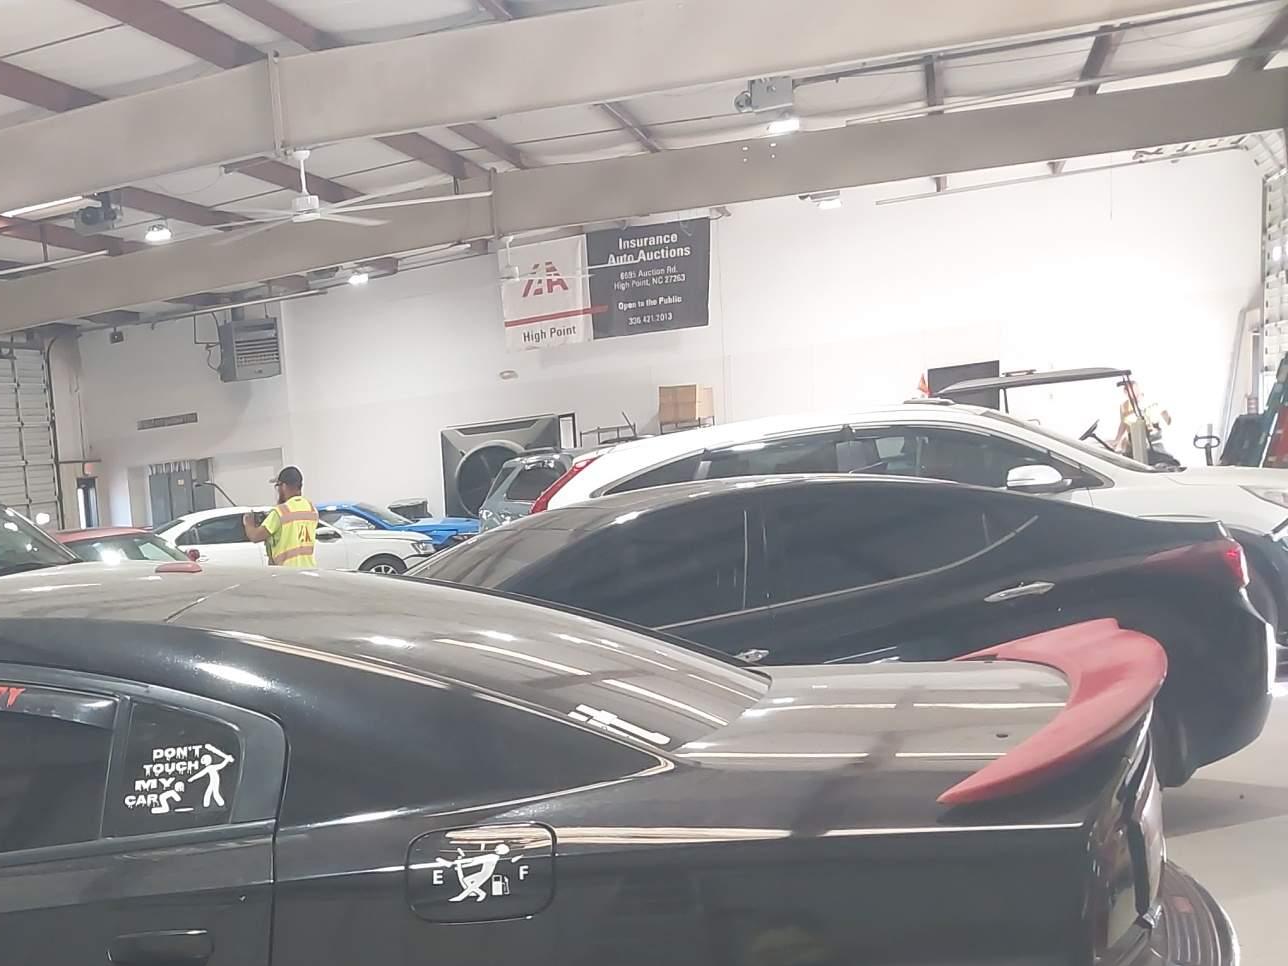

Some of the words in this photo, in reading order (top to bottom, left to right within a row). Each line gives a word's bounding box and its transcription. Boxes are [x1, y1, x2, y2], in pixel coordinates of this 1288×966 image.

[618, 232, 679, 251] Insurance
[607, 253, 635, 266] Auto
[637, 244, 691, 262] Auctions
[638, 267, 665, 278] Auction
[614, 281, 630, 291] High
[652, 276, 664, 285] NC
[618, 300, 634, 311] Open
[646, 297, 658, 306] the
[658, 294, 683, 305] Public
[522, 328, 548, 344] High
[549, 325, 578, 340] Point
[152, 745, 203, 761] DON'T
[143, 760, 199, 776] TOUCH
[135, 777, 175, 792] MY
[124, 793, 160, 809] CAR
[432, 869, 444, 885] E
[519, 865, 529, 880] F
